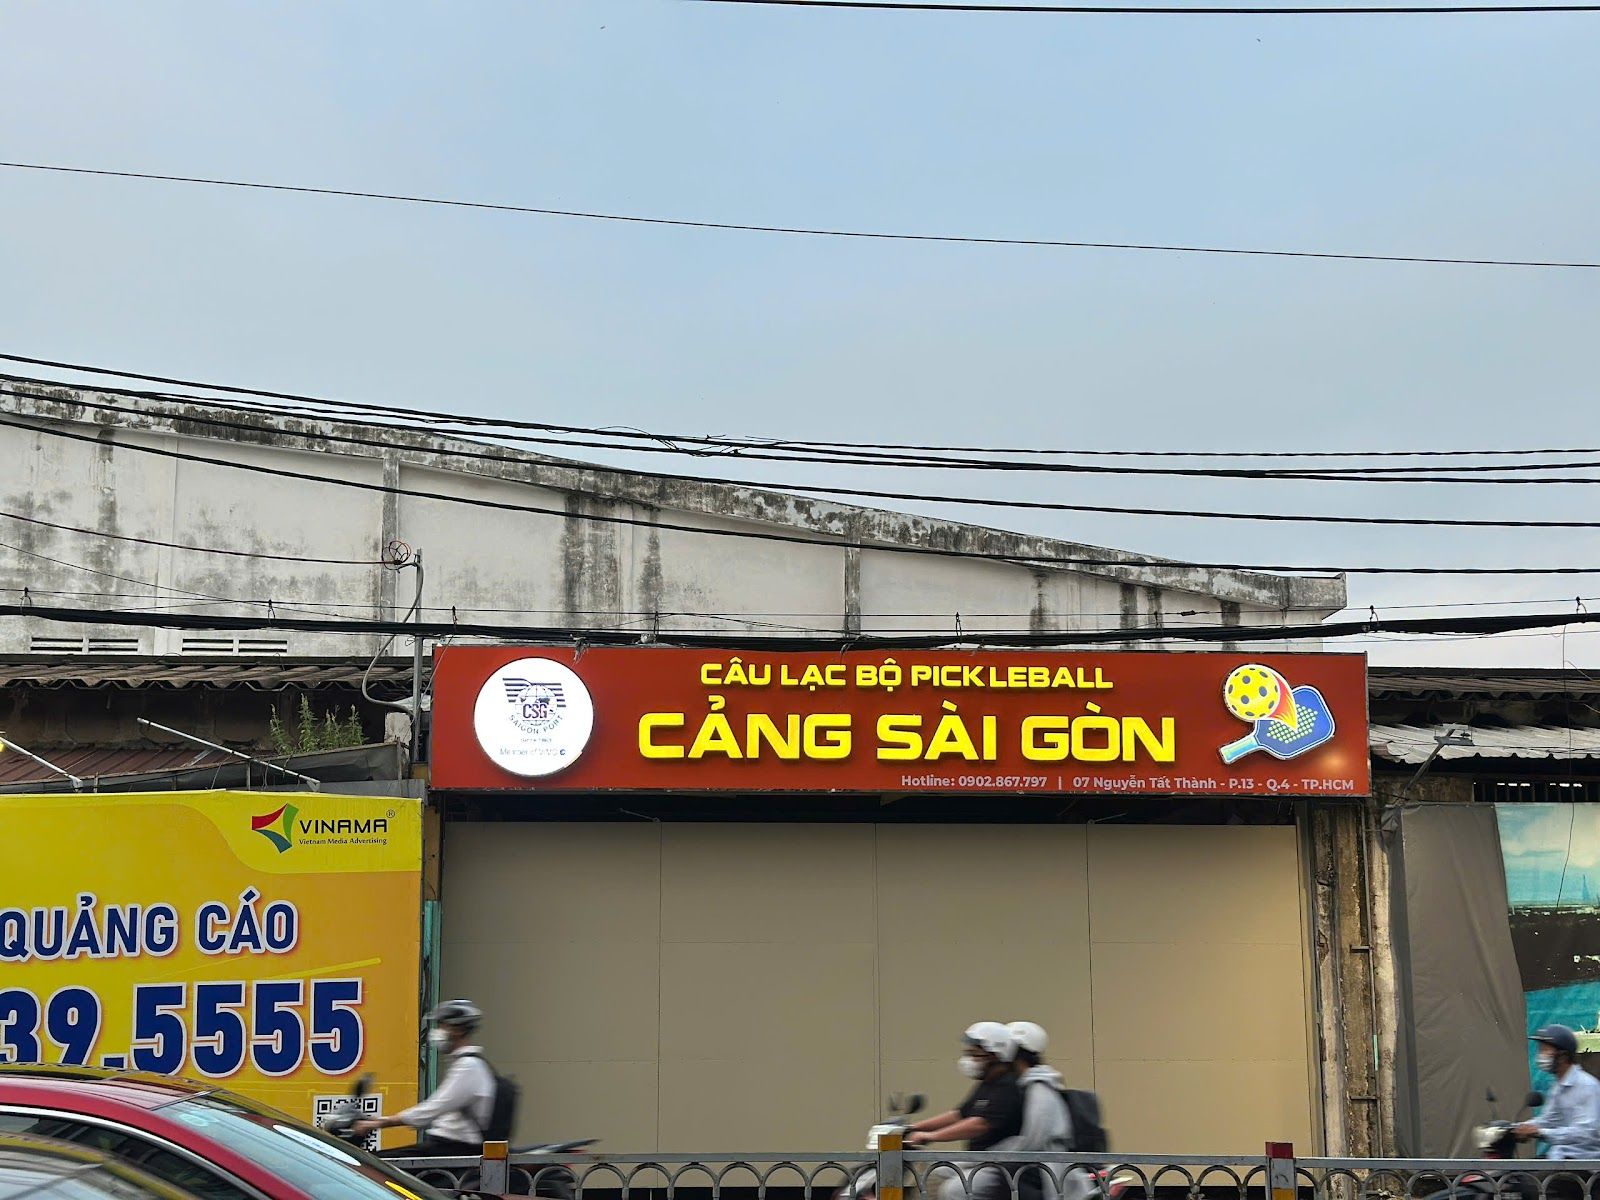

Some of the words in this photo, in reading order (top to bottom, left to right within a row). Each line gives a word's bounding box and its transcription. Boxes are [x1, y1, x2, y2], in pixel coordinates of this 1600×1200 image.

[700, 656, 771, 685] CÂU
[780, 664, 847, 691] LẠC
[855, 657, 902, 692] BỘ
[911, 665, 1114, 689] PICKLEBALL
[522, 703, 548, 719] CSG
[509, 714, 539, 734] SAIGON
[638, 695, 852, 760] CẢNG
[876, 700, 997, 761] SÀI
[1021, 701, 1176, 762] GÒN
[901, 774, 955, 787] Hotline:
[958, 775, 1048, 788] 0902.867.797
[1072, 776, 1089, 788] 07
[1093, 774, 1146, 791] Nguyễn
[1148, 775, 1171, 789] Tất
[1173, 776, 1217, 790] Thành
[1229, 778, 1255, 790] P.13
[1266, 778, 1290, 792] Q.4
[1301, 778, 1354, 790] TP.HCM
[299, 819, 388, 834] VINAMA
[349, 837, 387, 846] Advertising
[0, 893, 178, 961] QUẢNG
[195, 887, 298, 954] CÁO
[0, 978, 363, 1078] 39.5555
